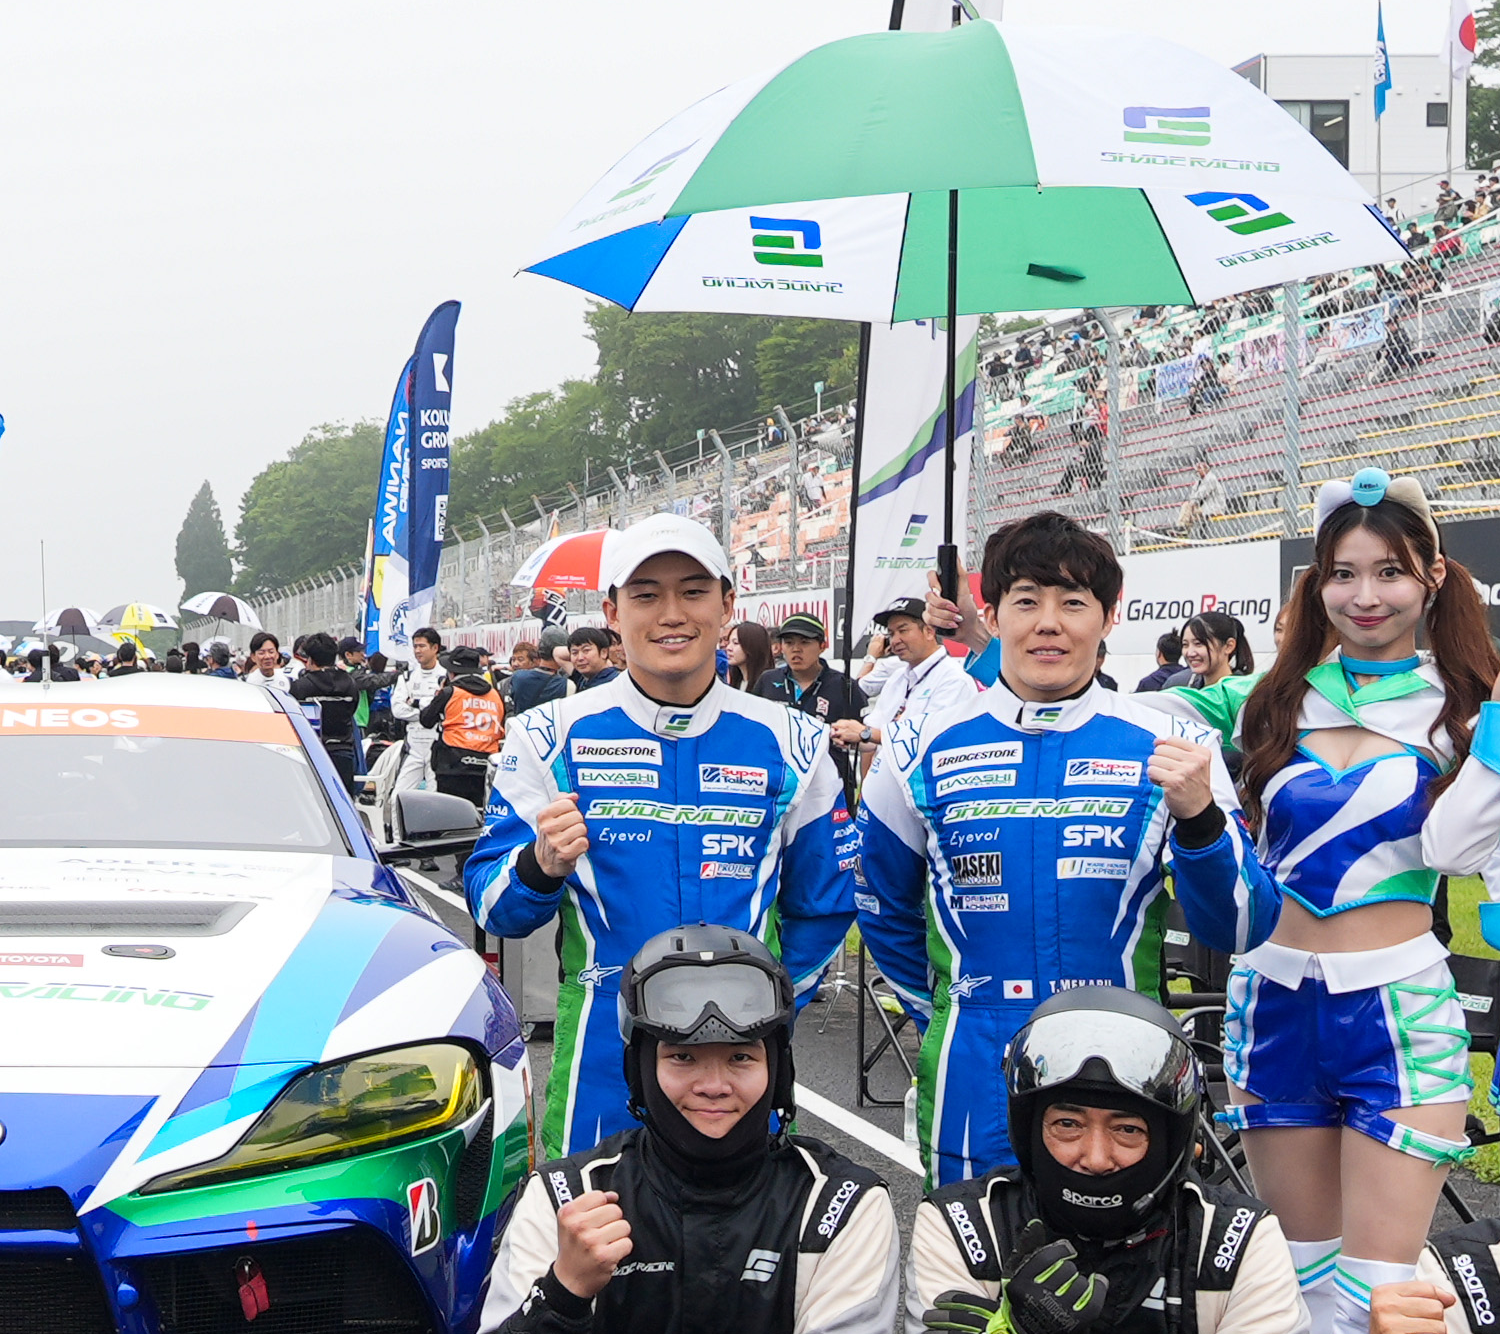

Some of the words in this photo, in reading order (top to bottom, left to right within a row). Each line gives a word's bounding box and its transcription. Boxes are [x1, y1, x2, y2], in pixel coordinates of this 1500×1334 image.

[1126, 598, 1194, 622] GAZOO
[1199, 593, 1272, 624] Racing
[462, 697, 498, 711] MEDIA
[577, 745, 657, 757] BRIDGESTONE
[936, 749, 1018, 769] BRIDGESTONE
[721, 768, 764, 778] Super
[1090, 760, 1138, 770] Super
[1090, 768, 1136, 777] Taikyu
[582, 772, 655, 783] HAYASHI
[720, 776, 763, 787] Taikyu
[939, 773, 1012, 792] HAYASHI
[599, 827, 652, 845] Eyevol
[702, 833, 756, 857] SPK
[949, 826, 1000, 848] Eyevol
[1062, 825, 1126, 849] SPK
[717, 864, 755, 874] PROJECT
[1085, 868, 1128, 876] EXPRESS
[1062, 1187, 1124, 1209] sparco
[818, 1179, 858, 1239] sparco
[945, 1201, 987, 1264] sparco
[1214, 1207, 1255, 1269] sparco
[1452, 1253, 1496, 1325] sparco
